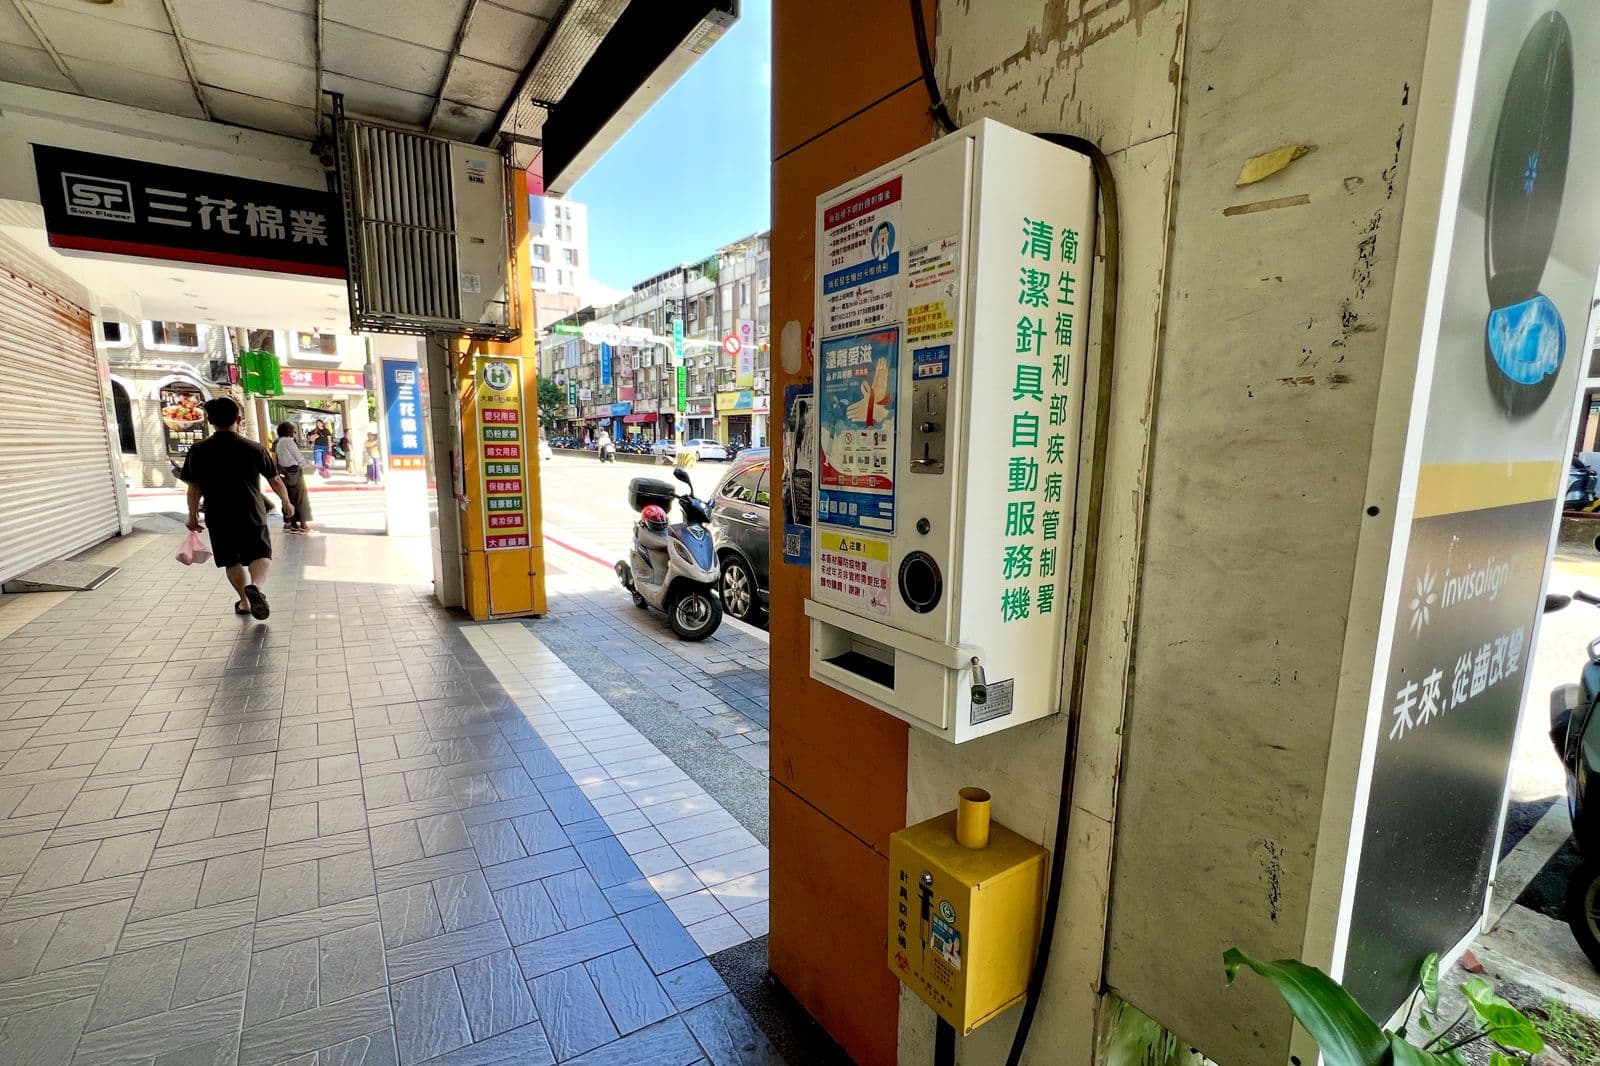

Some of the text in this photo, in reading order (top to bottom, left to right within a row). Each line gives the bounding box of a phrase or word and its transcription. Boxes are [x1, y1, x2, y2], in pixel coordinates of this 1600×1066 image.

[70, 207, 132, 220] Sun Flower
[145, 187, 328, 246] 三花棉業
[831, 257, 844, 266] 1922
[826, 344, 872, 369] 遠離愛滋
[399, 386, 418, 449] 三花棉業
[484, 411, 517, 421] 嬰兒用品
[1001, 216, 1054, 623] 清潔針具自動服務機
[1036, 228, 1078, 615] 衛生福利部疾病管制署
[487, 447, 518, 457] 婦女用品
[489, 482, 520, 491] 保健食品
[1441, 556, 1509, 608] invisalign
